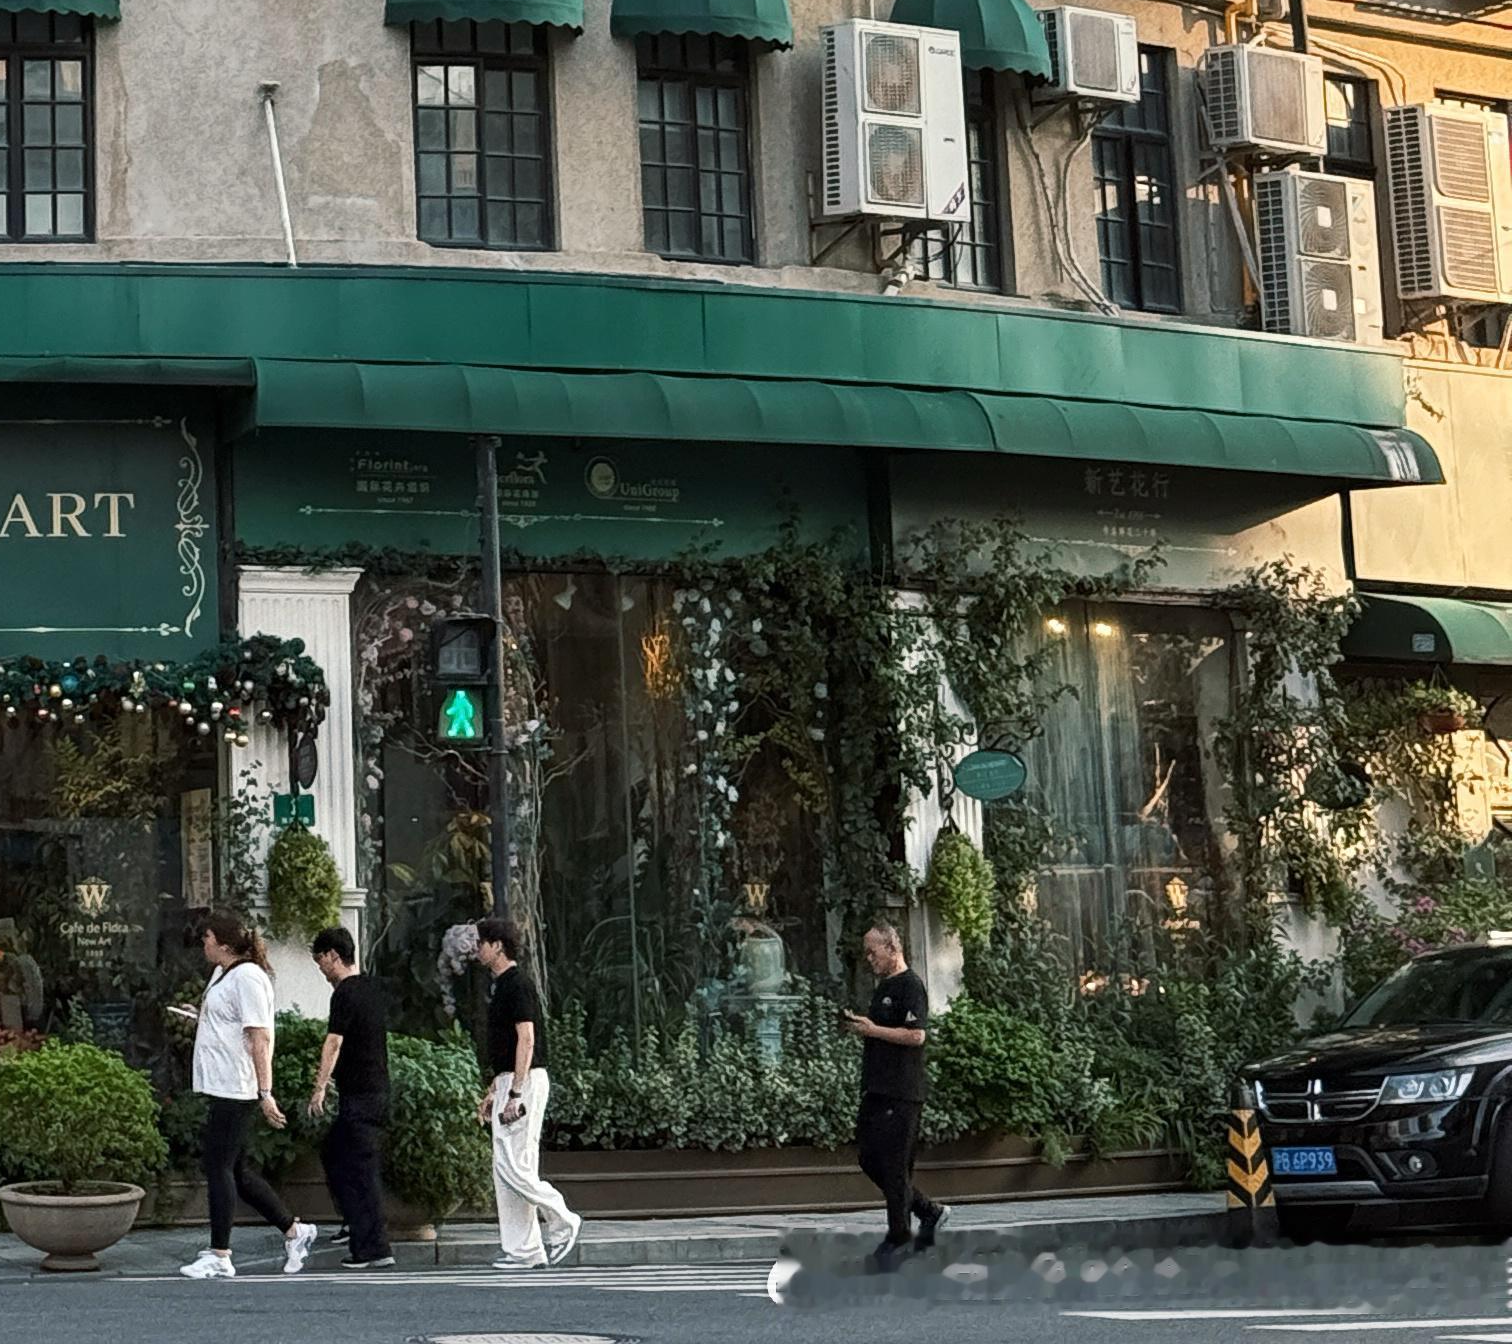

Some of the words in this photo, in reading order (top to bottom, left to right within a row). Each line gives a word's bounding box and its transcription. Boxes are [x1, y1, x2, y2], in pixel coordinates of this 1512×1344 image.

[620, 482, 679, 502] UniGroup
[1084, 466, 1169, 499] 新艺花行
[75, 884, 112, 910] W
[742, 883, 771, 908] W
[86, 921, 101, 934] de
